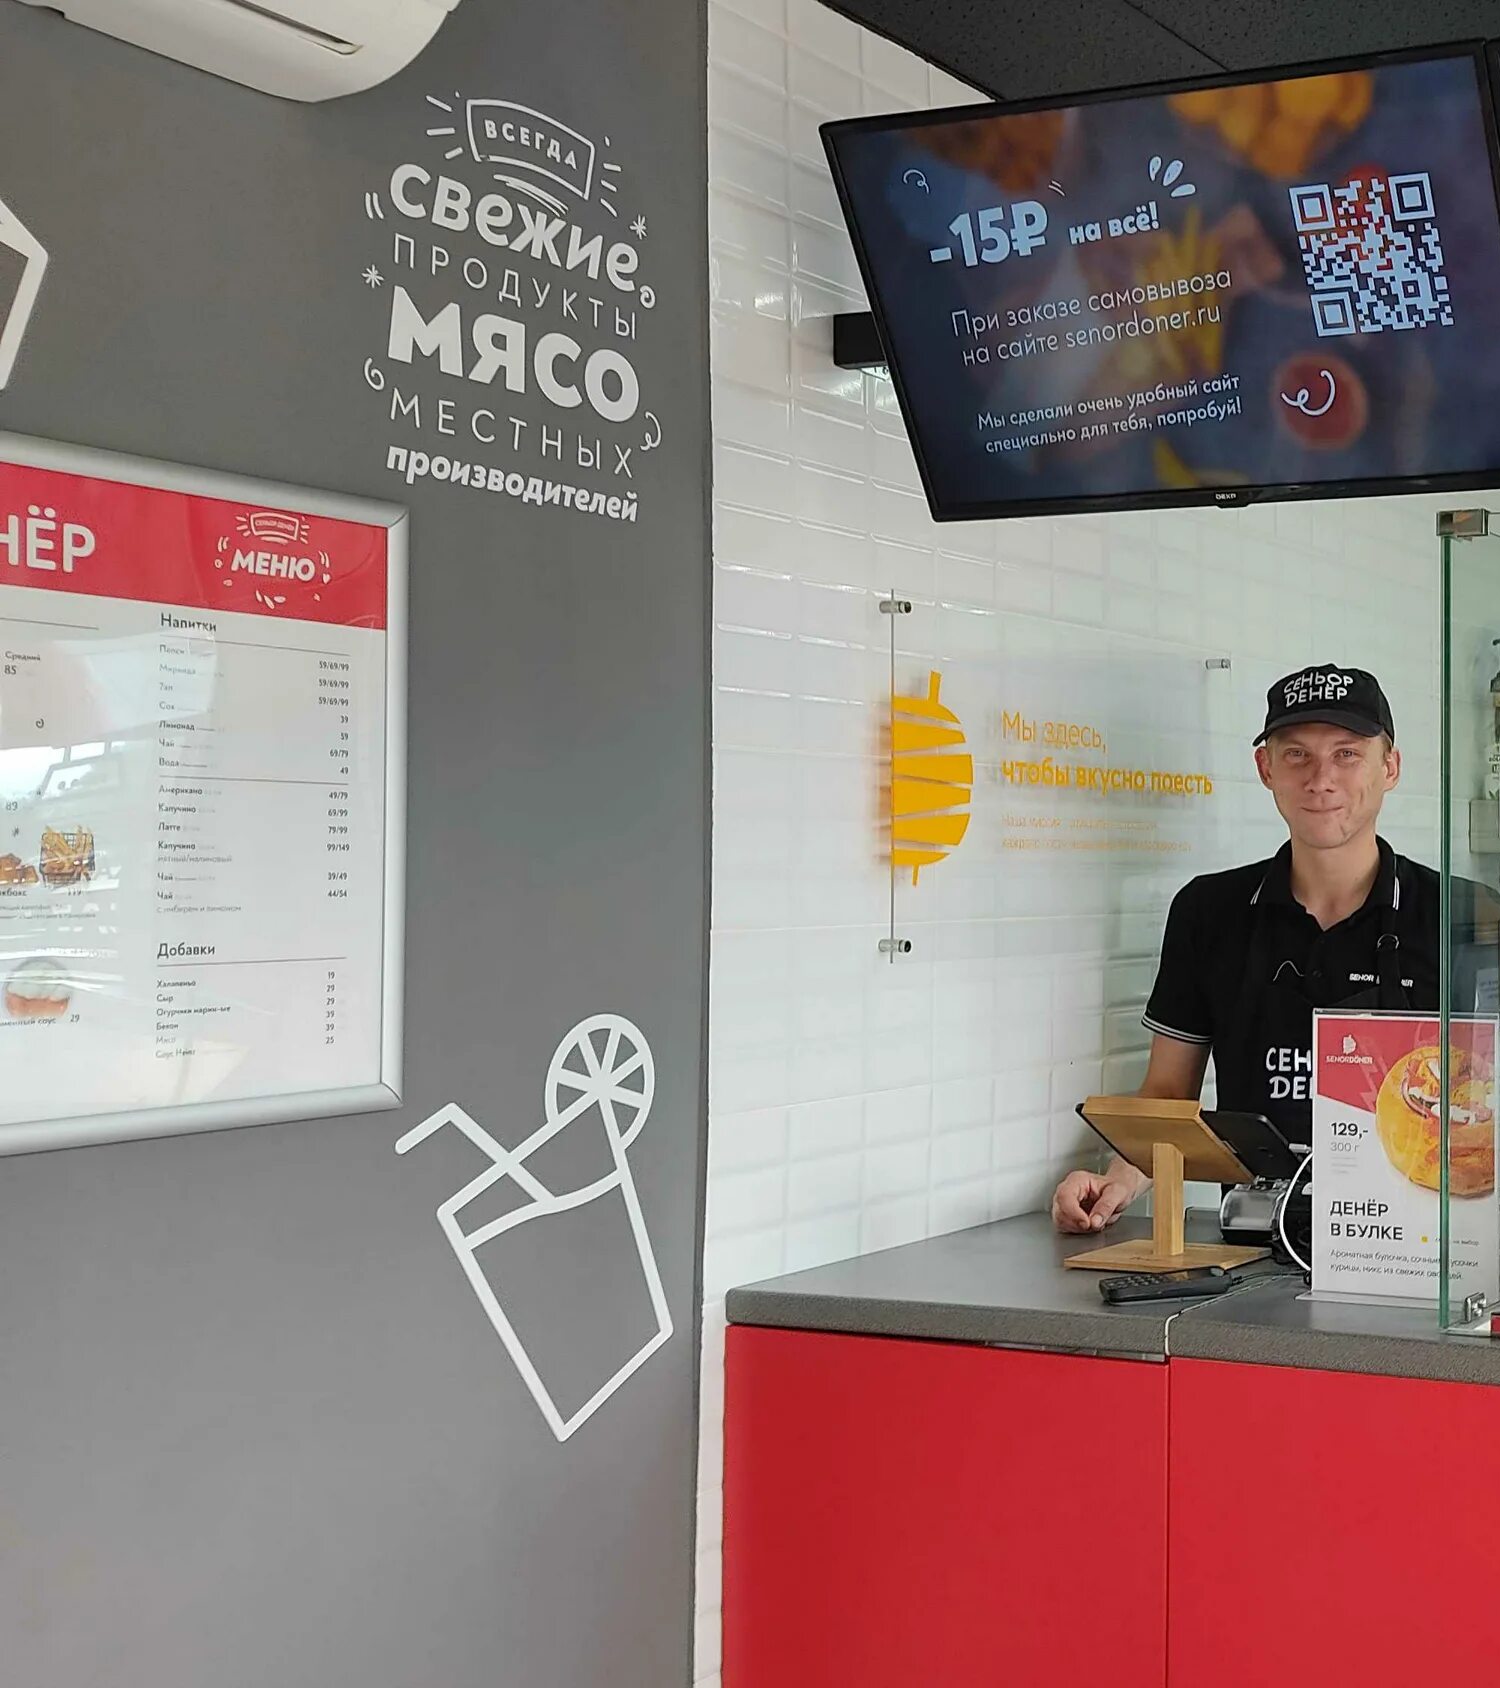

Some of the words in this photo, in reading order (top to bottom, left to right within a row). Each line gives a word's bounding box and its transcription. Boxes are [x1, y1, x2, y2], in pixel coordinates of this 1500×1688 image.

[484, 118, 578, 170] ВСЕГДА
[930, 200, 1048, 267] -15₽
[1069, 222, 1102, 245] на
[1108, 201, 1160, 237] всё!
[393, 233, 637, 340] ПРОДУКТЫ
[951, 309, 1000, 340] При
[1007, 297, 1081, 327] заказе
[1088, 270, 1231, 311] самовывоза
[962, 348, 990, 366] на
[997, 332, 1058, 359] сайте
[1065, 304, 1222, 349] senordoner.ru
[977, 412, 1006, 431] Мы
[1010, 404, 1074, 427] сделали
[1078, 397, 1123, 414] очень
[1127, 380, 1199, 407] удобный
[1202, 374, 1240, 393] сайт
[985, 428, 1077, 453] специально
[1080, 424, 1109, 441] для
[1112, 414, 1153, 434] тебя,
[1157, 396, 1242, 427] попробуй!
[389, 386, 634, 479] МЕСТНЫХ
[386, 446, 639, 523] производителей
[231, 548, 316, 582] МЕНЮ
[160, 612, 218, 633] Напитки
[1283, 671, 1354, 693] СЕНЬОР
[1002, 711, 1036, 744] Мы
[1044, 721, 1107, 752] здесь,
[1002, 757, 1070, 787] чтобы
[1075, 766, 1146, 796] вкусно
[1151, 770, 1213, 796] поесть
[156, 942, 216, 959] Добавки
[1330, 1142, 1352, 1152] 300
[1330, 1198, 1389, 1218] ДЕНЁР
[1330, 1222, 1341, 1236] В
[1346, 1223, 1404, 1241] БУЛКЕ
